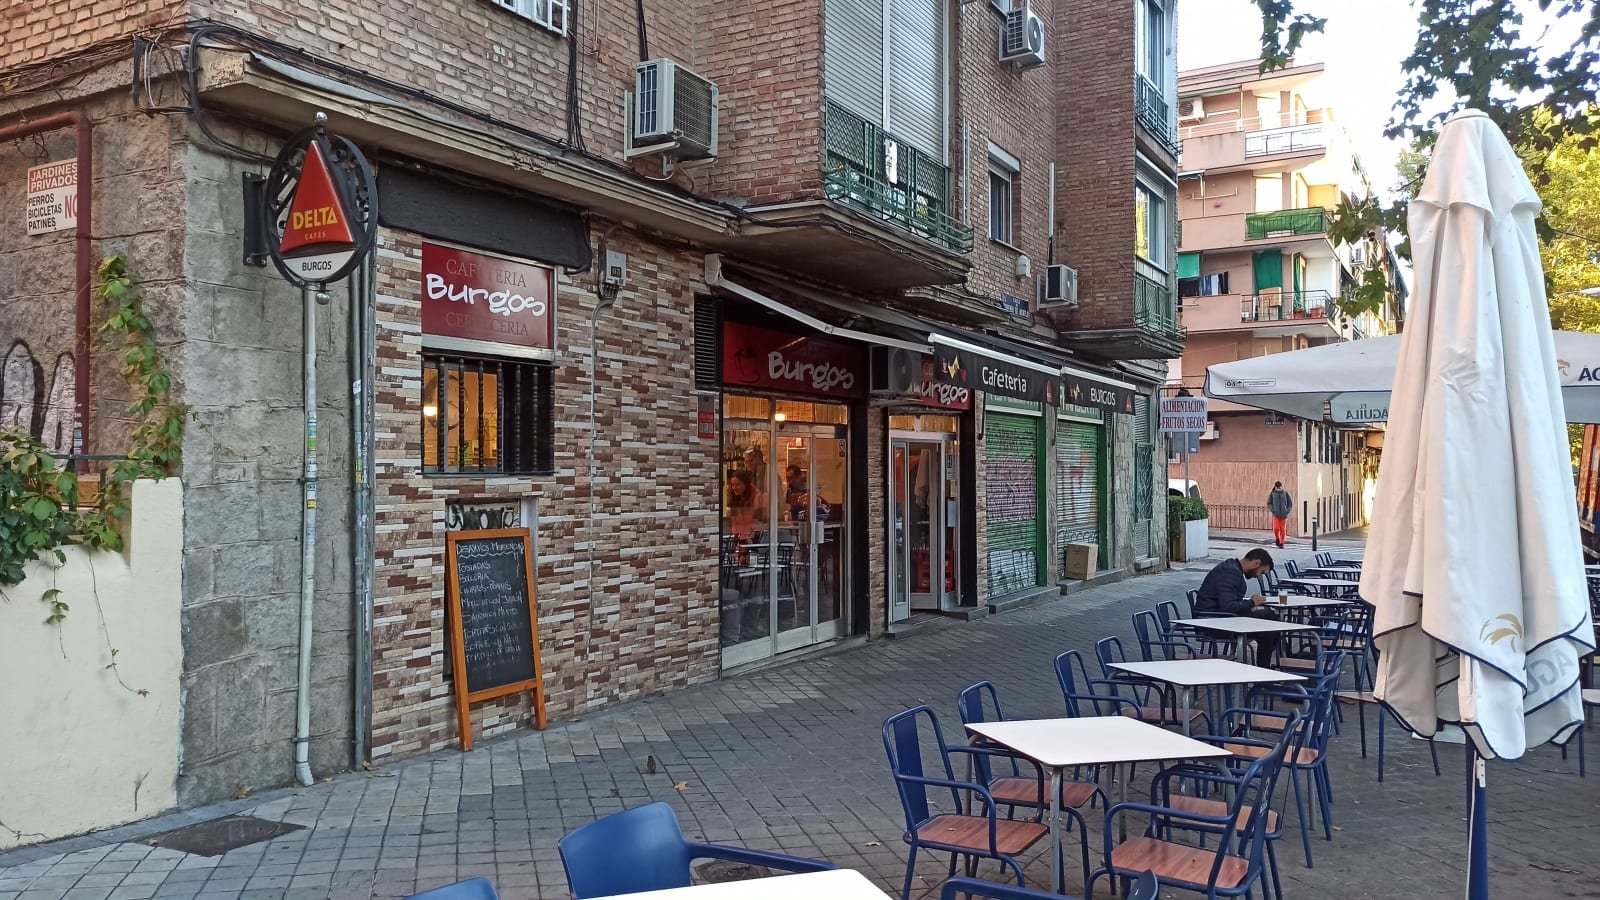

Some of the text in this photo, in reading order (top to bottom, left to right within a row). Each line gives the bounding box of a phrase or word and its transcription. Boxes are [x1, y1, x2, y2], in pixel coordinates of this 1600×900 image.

[31, 162, 78, 181] JARDINES
[31, 173, 78, 192] PRIVADOS
[28, 193, 55, 206] PERROS
[28, 203, 62, 219] BICICLETAS
[293, 206, 338, 230] DELTA
[28, 217, 56, 230] PATINES
[302, 261, 332, 271] BURGOS
[446, 259, 527, 288] CAFTERIA
[426, 273, 546, 317] Burgos
[768, 351, 854, 391] Burgos
[982, 366, 1027, 392] Cafetería
[921, 381, 968, 405] urgos
[1090, 386, 1116, 406] BURGOS
[1162, 416, 1205, 429] FRUTOS SECOS
